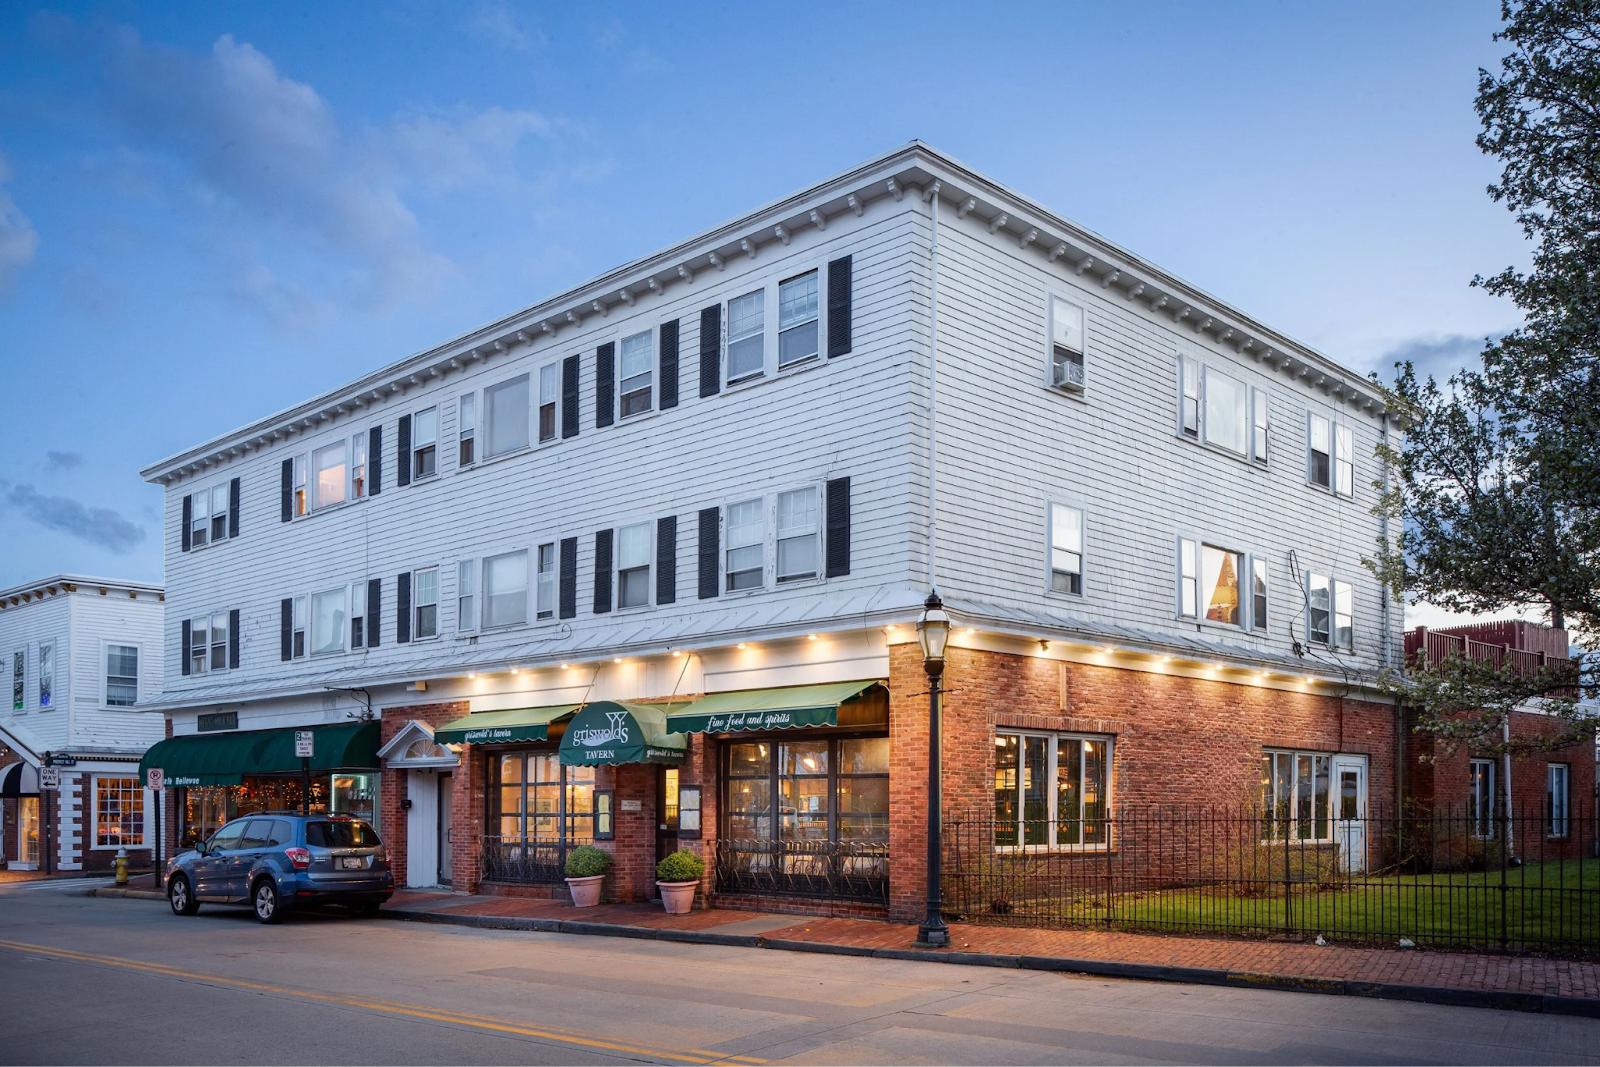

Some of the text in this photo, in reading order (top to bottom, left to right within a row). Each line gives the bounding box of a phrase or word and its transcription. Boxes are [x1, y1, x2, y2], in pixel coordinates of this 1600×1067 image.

[707, 713, 790, 732] fine food and spirits
[585, 750, 615, 759] TAVERN
